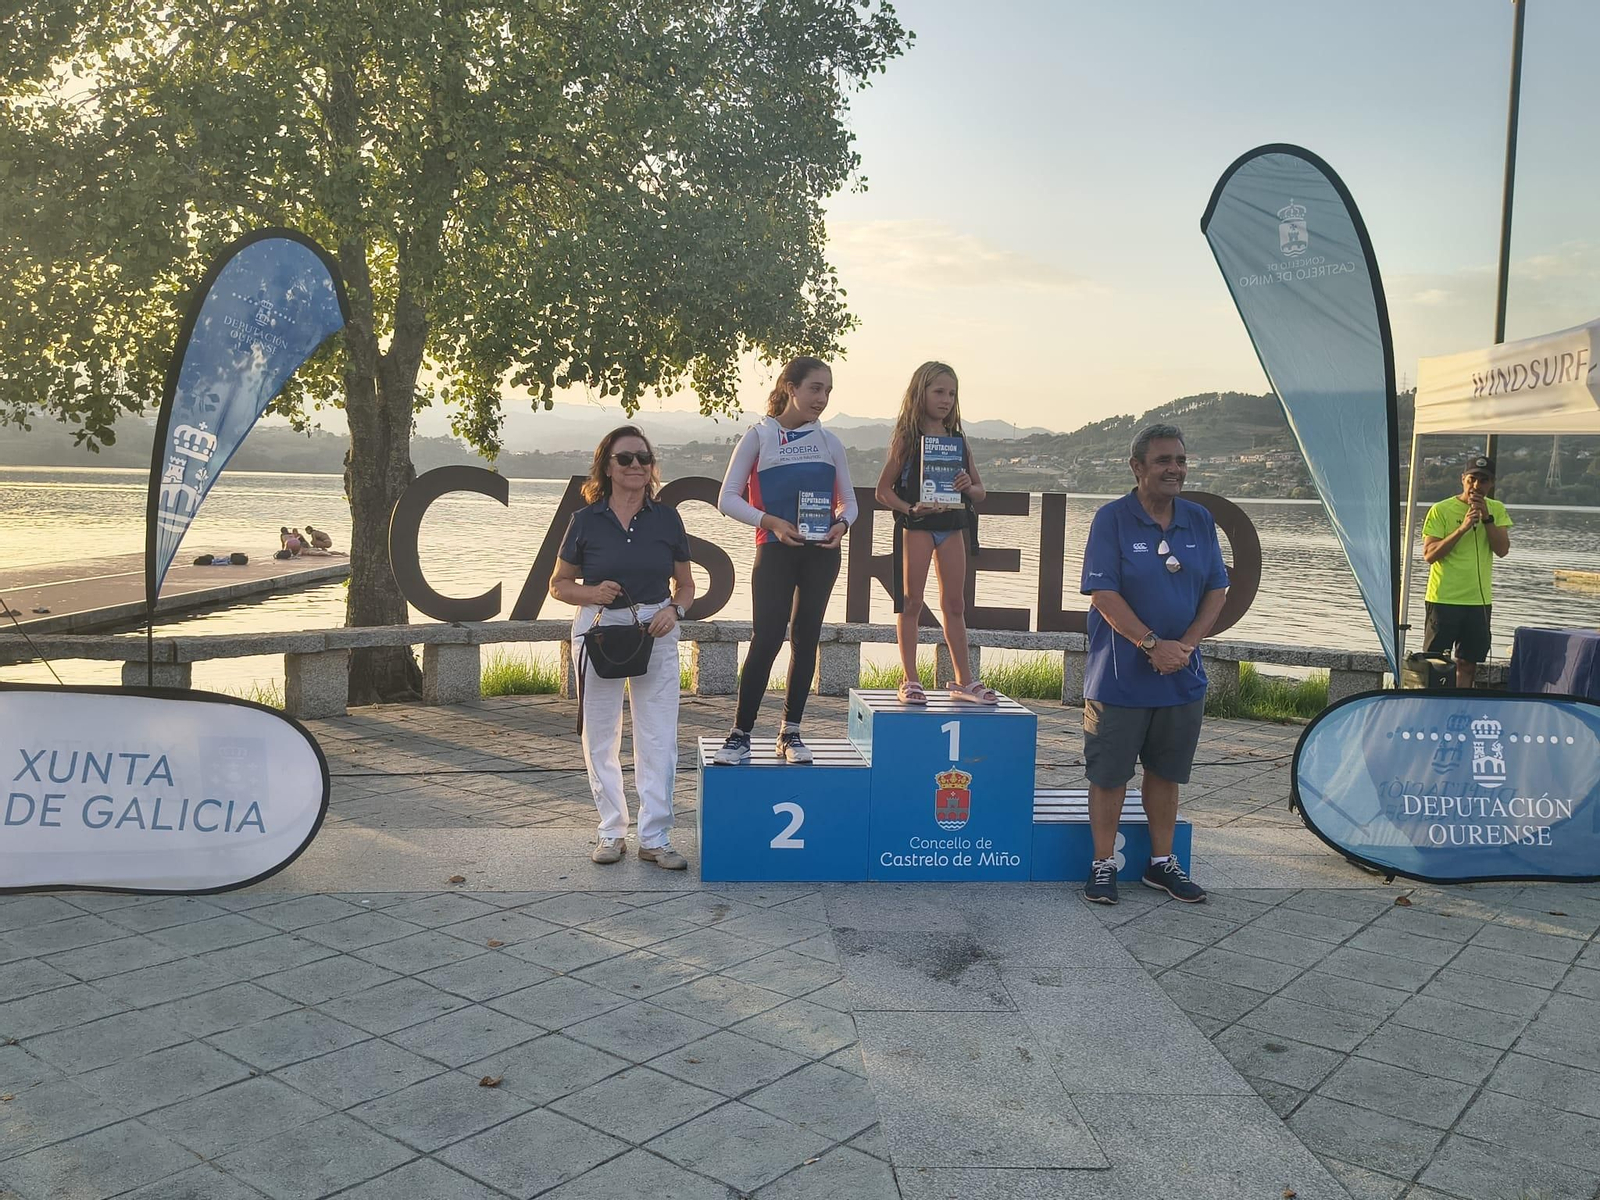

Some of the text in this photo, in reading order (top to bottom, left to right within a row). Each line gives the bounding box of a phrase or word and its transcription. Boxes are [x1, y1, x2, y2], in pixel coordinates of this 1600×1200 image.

[779, 445, 819, 454] RODEIRA
[925, 437, 939, 445] COPA
[941, 721, 960, 761] 1
[13, 749, 174, 787] XUNTA
[4, 792, 66, 827] DE
[82, 795, 266, 834] GALICIA
[1402, 792, 1573, 819] DEPUTACIÓN
[770, 802, 804, 848] 2
[1428, 824, 1552, 846] OURENSE
[910, 837, 992, 849] Concello de
[880, 852, 1020, 867] Castrelo de Miño
